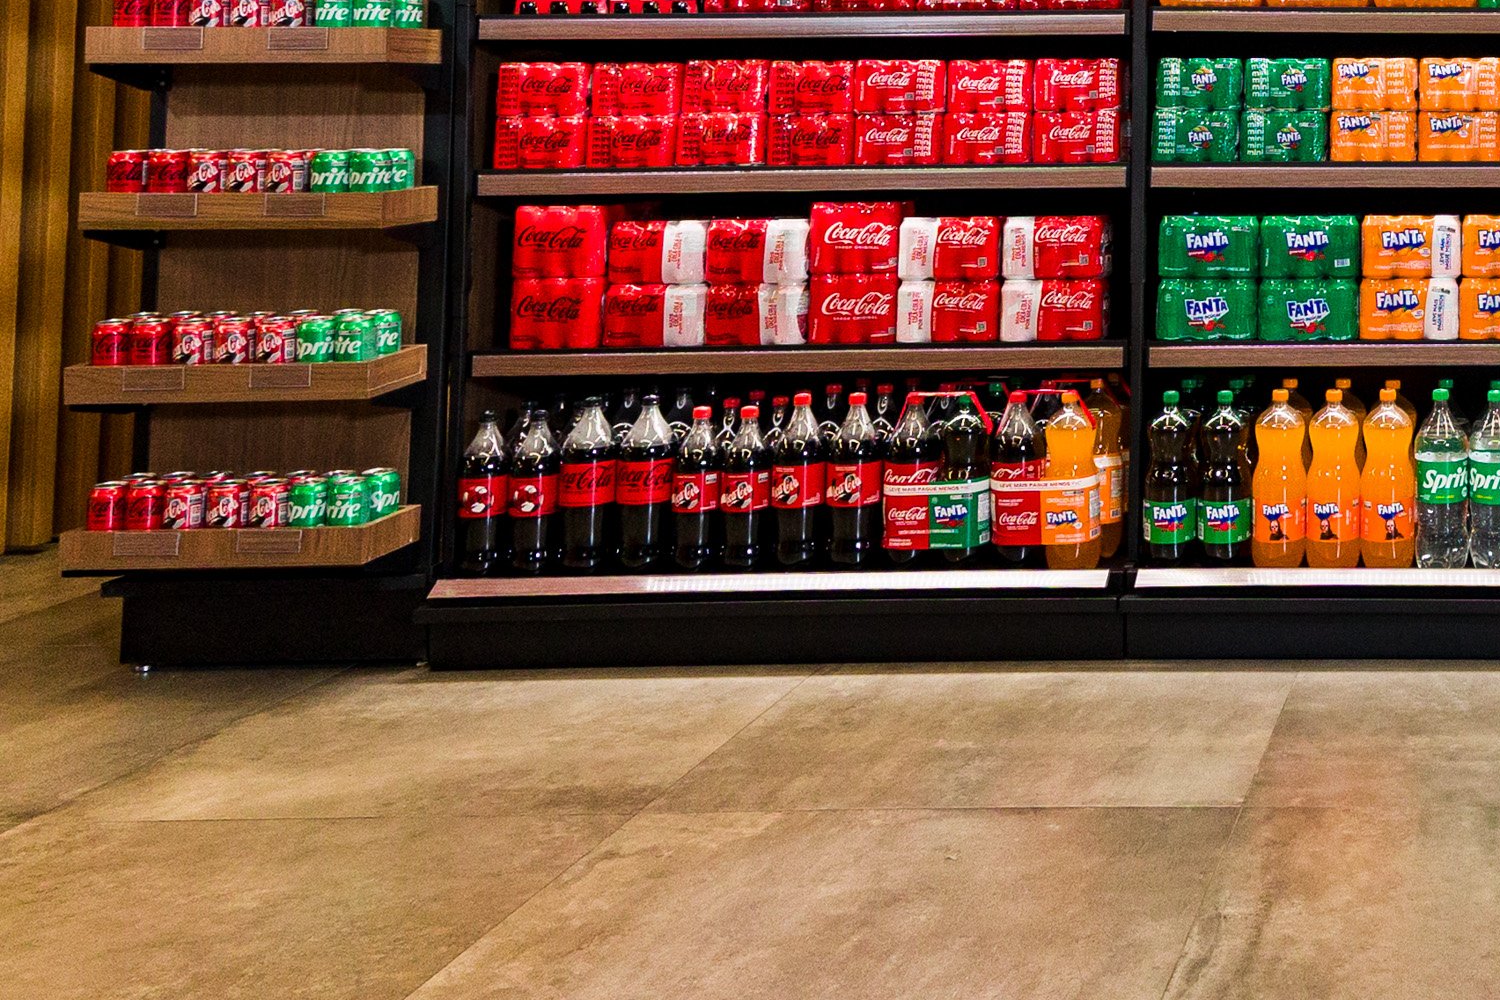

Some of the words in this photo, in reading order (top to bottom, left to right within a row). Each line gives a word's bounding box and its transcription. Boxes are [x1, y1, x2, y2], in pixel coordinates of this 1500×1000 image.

[1338, 63, 1369, 77] FANTA
[867, 72, 910, 86] Coca-Cola
[958, 76, 1000, 90] Coca-Cola
[1430, 118, 1463, 131] FANTA
[866, 128, 909, 142] Coca-Cola
[1050, 125, 1091, 140] Coca-Cola
[350, 167, 391, 188] prite
[517, 225, 587, 250] Coca-Cola
[823, 221, 897, 246] Coca-Cola
[938, 224, 992, 246] Coca-Cola
[1035, 223, 1090, 244] Coca-Cola
[1186, 231, 1229, 250] FANTA
[1286, 231, 1329, 249] FANTA
[821, 292, 894, 315] Coca-Cola
[1186, 299, 1228, 318] FANTA
[888, 506, 928, 520] Coca-Cola
[934, 504, 968, 518] FANTA
[1153, 504, 1187, 520] FANTA
[1262, 503, 1289, 516] FANTA
[1377, 503, 1404, 516] FANTA
[999, 511, 1038, 525] Coca-Cola
[1047, 510, 1077, 524] FANTA
